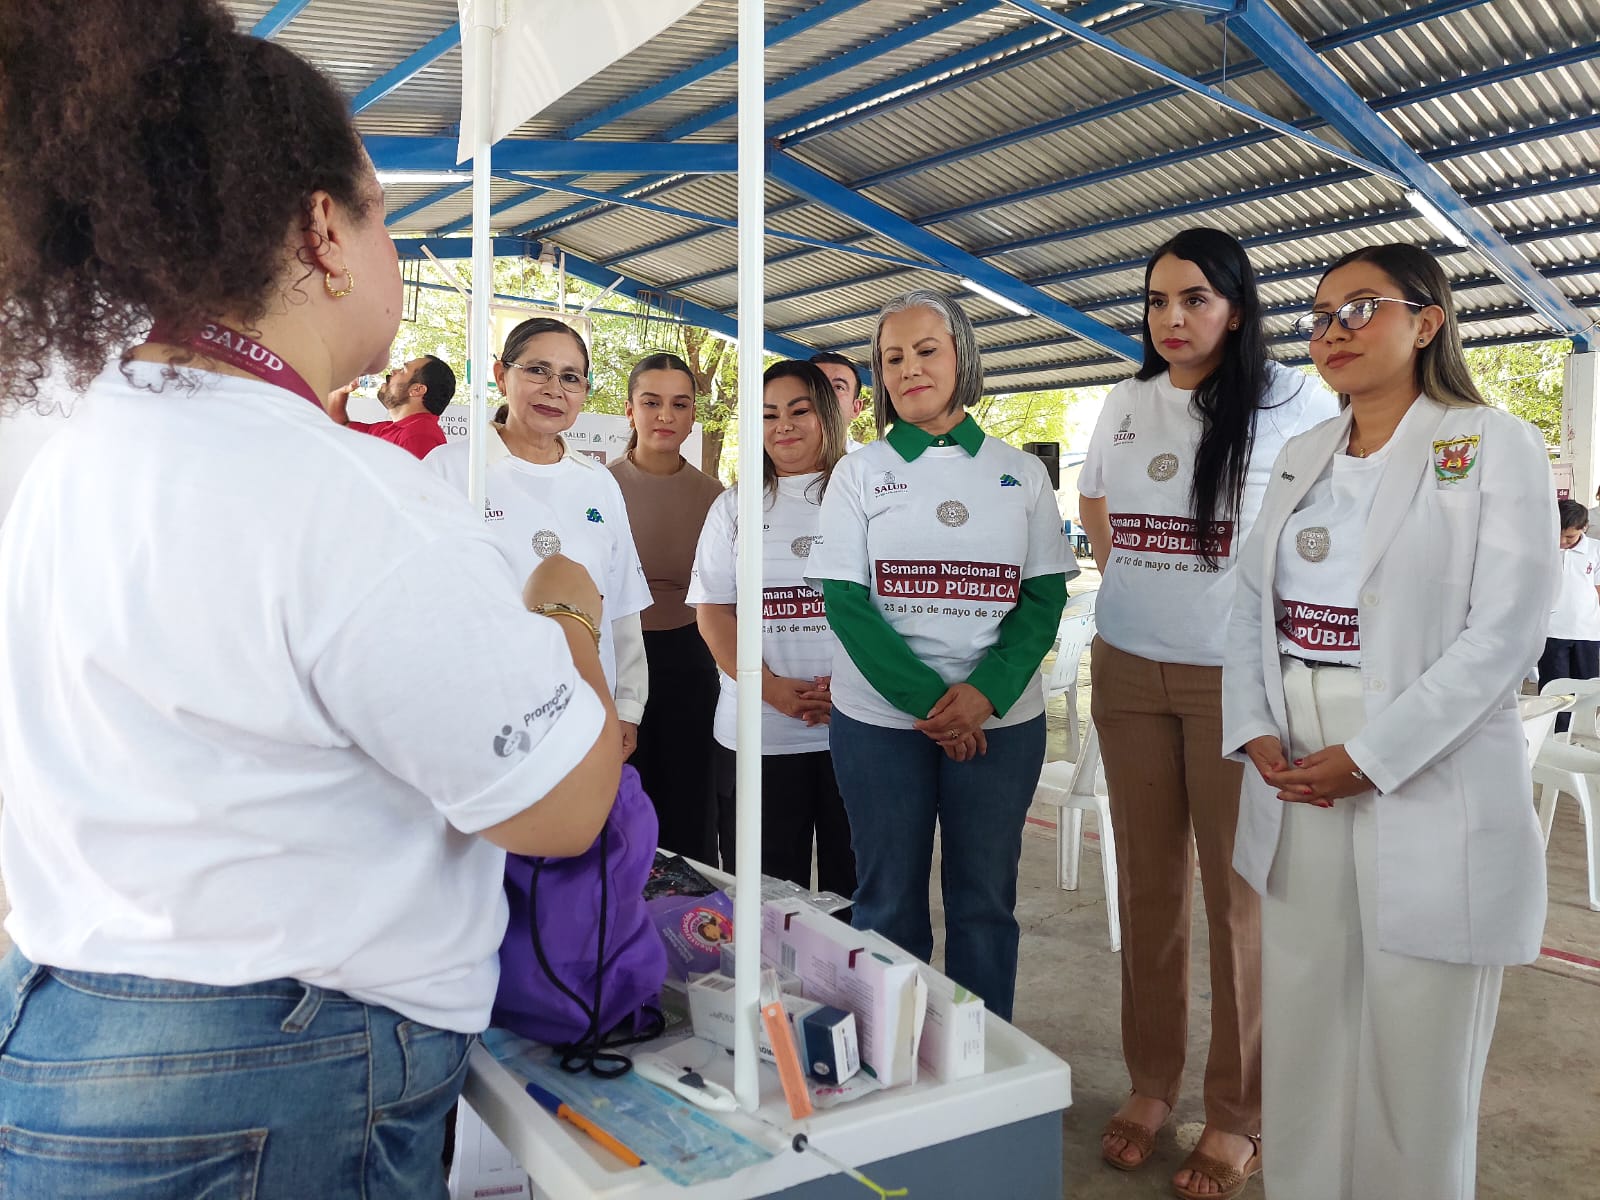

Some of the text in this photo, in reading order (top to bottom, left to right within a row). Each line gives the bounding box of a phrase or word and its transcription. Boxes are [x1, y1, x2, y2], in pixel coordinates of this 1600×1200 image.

[201, 324, 284, 371] SALUD
[443, 423, 468, 436] ico
[875, 483, 908, 495] SALUD
[485, 510, 503, 518] LUD
[1145, 517, 1198, 532] Naciona
[882, 562, 1017, 579] Semana Nacional de
[1133, 557, 1143, 566] de
[1145, 560, 1171, 571] mayo
[1175, 561, 1189, 571] de
[763, 590, 794, 600] mana
[883, 578, 1015, 599] SALUD PÚBLICA
[763, 603, 798, 617] ALUD
[898, 604, 907, 613] al
[911, 604, 923, 614] 30
[927, 604, 939, 614] de
[942, 607, 971, 618] mayo
[975, 608, 988, 617] de
[991, 610, 1008, 618] 20
[1295, 604, 1359, 626] Naciona
[776, 624, 787, 633] 30
[789, 624, 800, 633] de
[803, 624, 827, 633] mayo
[1297, 623, 1360, 647] PÚBLI
